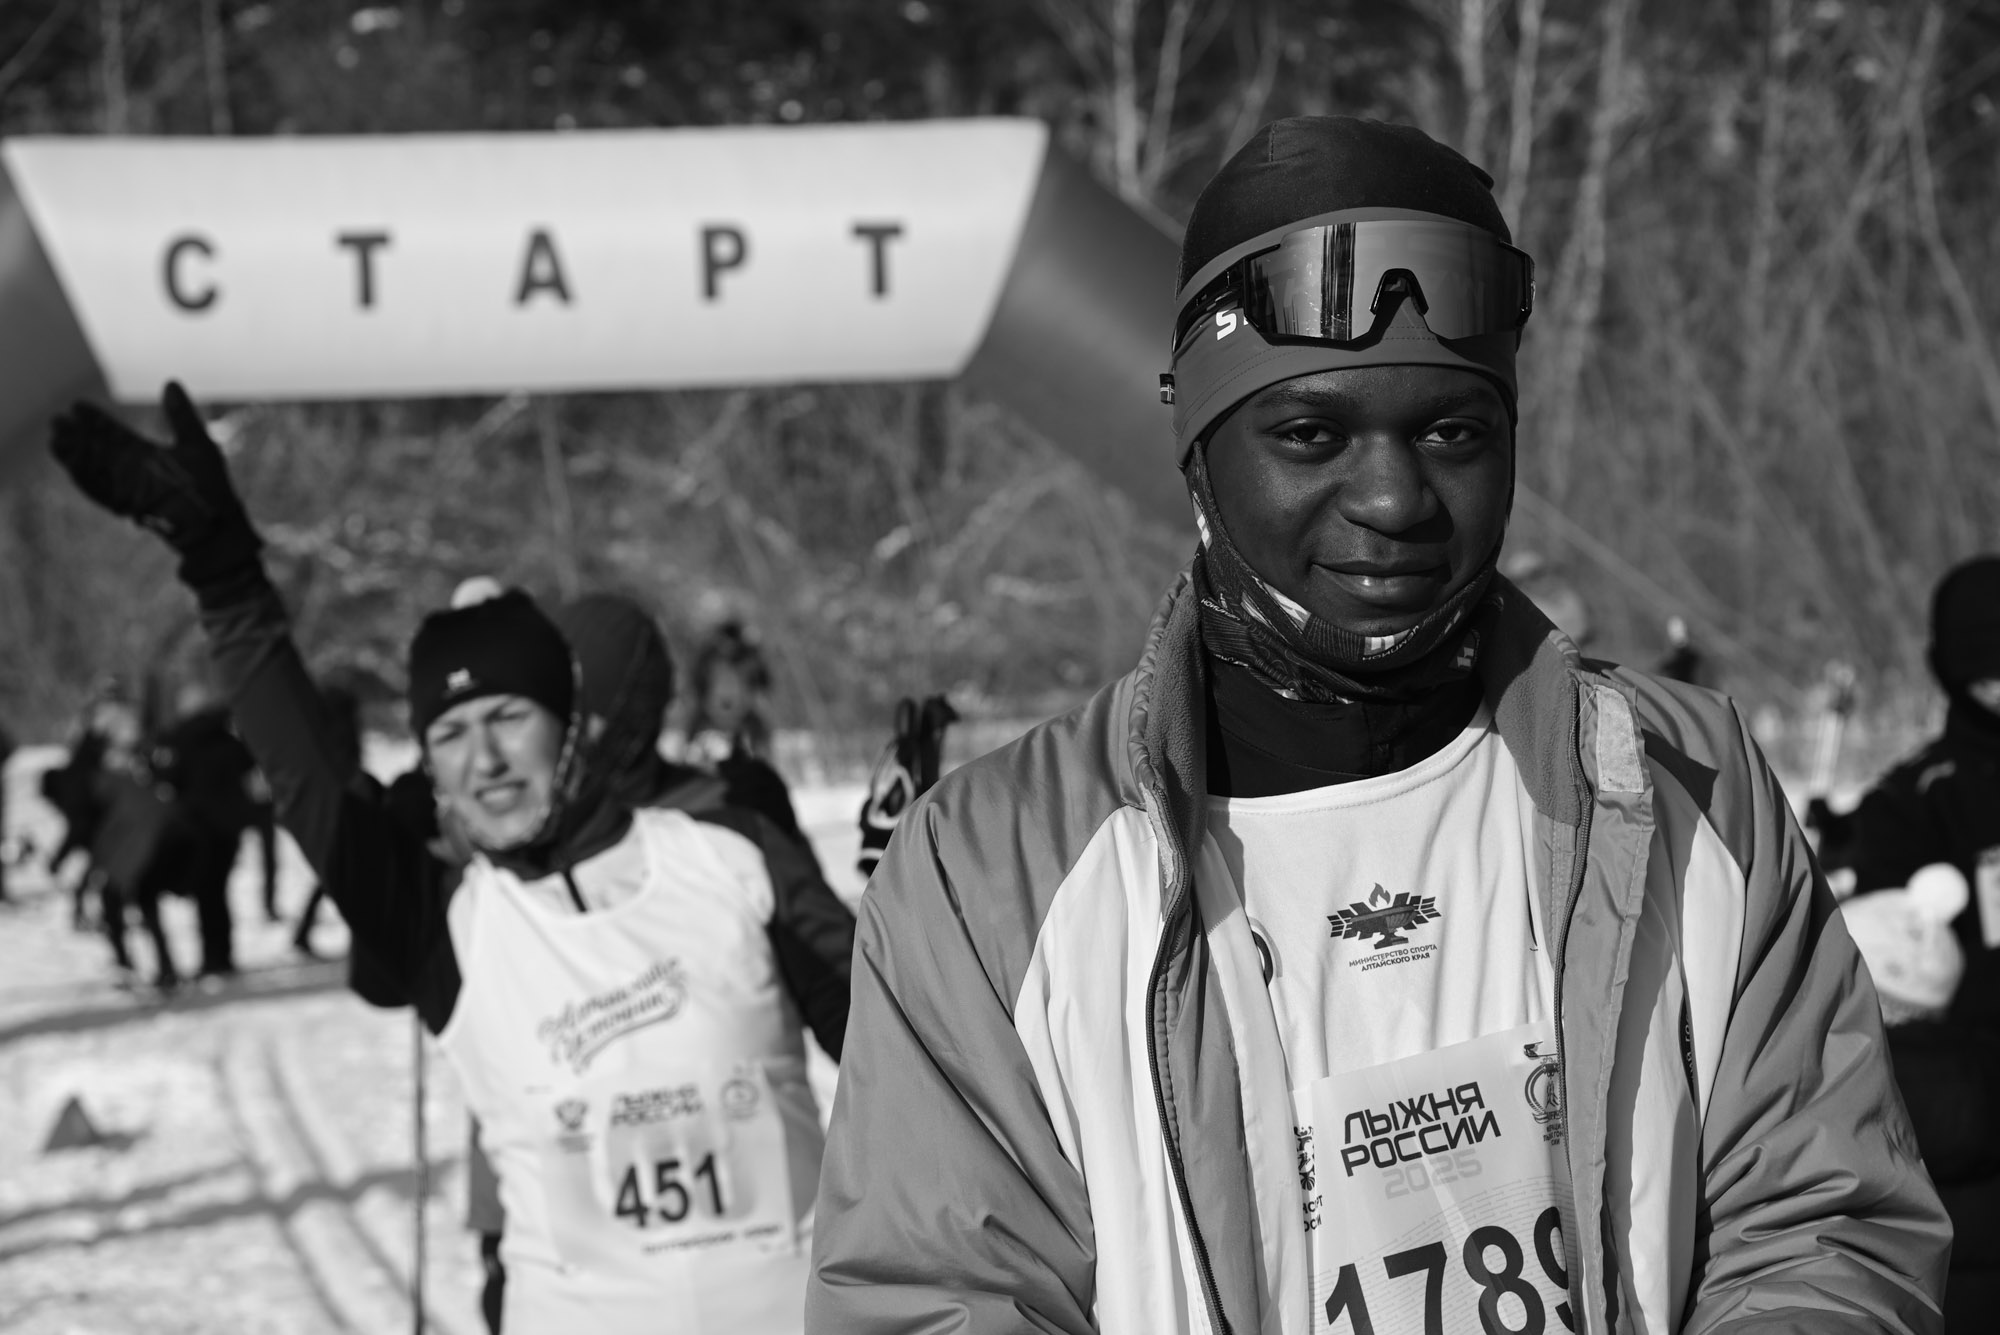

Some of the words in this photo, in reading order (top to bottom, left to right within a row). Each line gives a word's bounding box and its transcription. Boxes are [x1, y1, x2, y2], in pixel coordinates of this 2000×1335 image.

[160, 222, 906, 314] СТАРТ
[1349, 948, 1409, 968] МИНИСТЕРСТВО
[1410, 943, 1438, 955] СПОРТА
[1361, 955, 1411, 972] АЛТАЙСКОГО
[1411, 952, 1431, 962] КРАЯ
[1340, 1110, 1502, 1177] РОССИИ
[1344, 1081, 1486, 1145] ЛЫЖНЯ
[615, 1152, 726, 1229] 451
[1381, 1148, 1484, 1200] 2025
